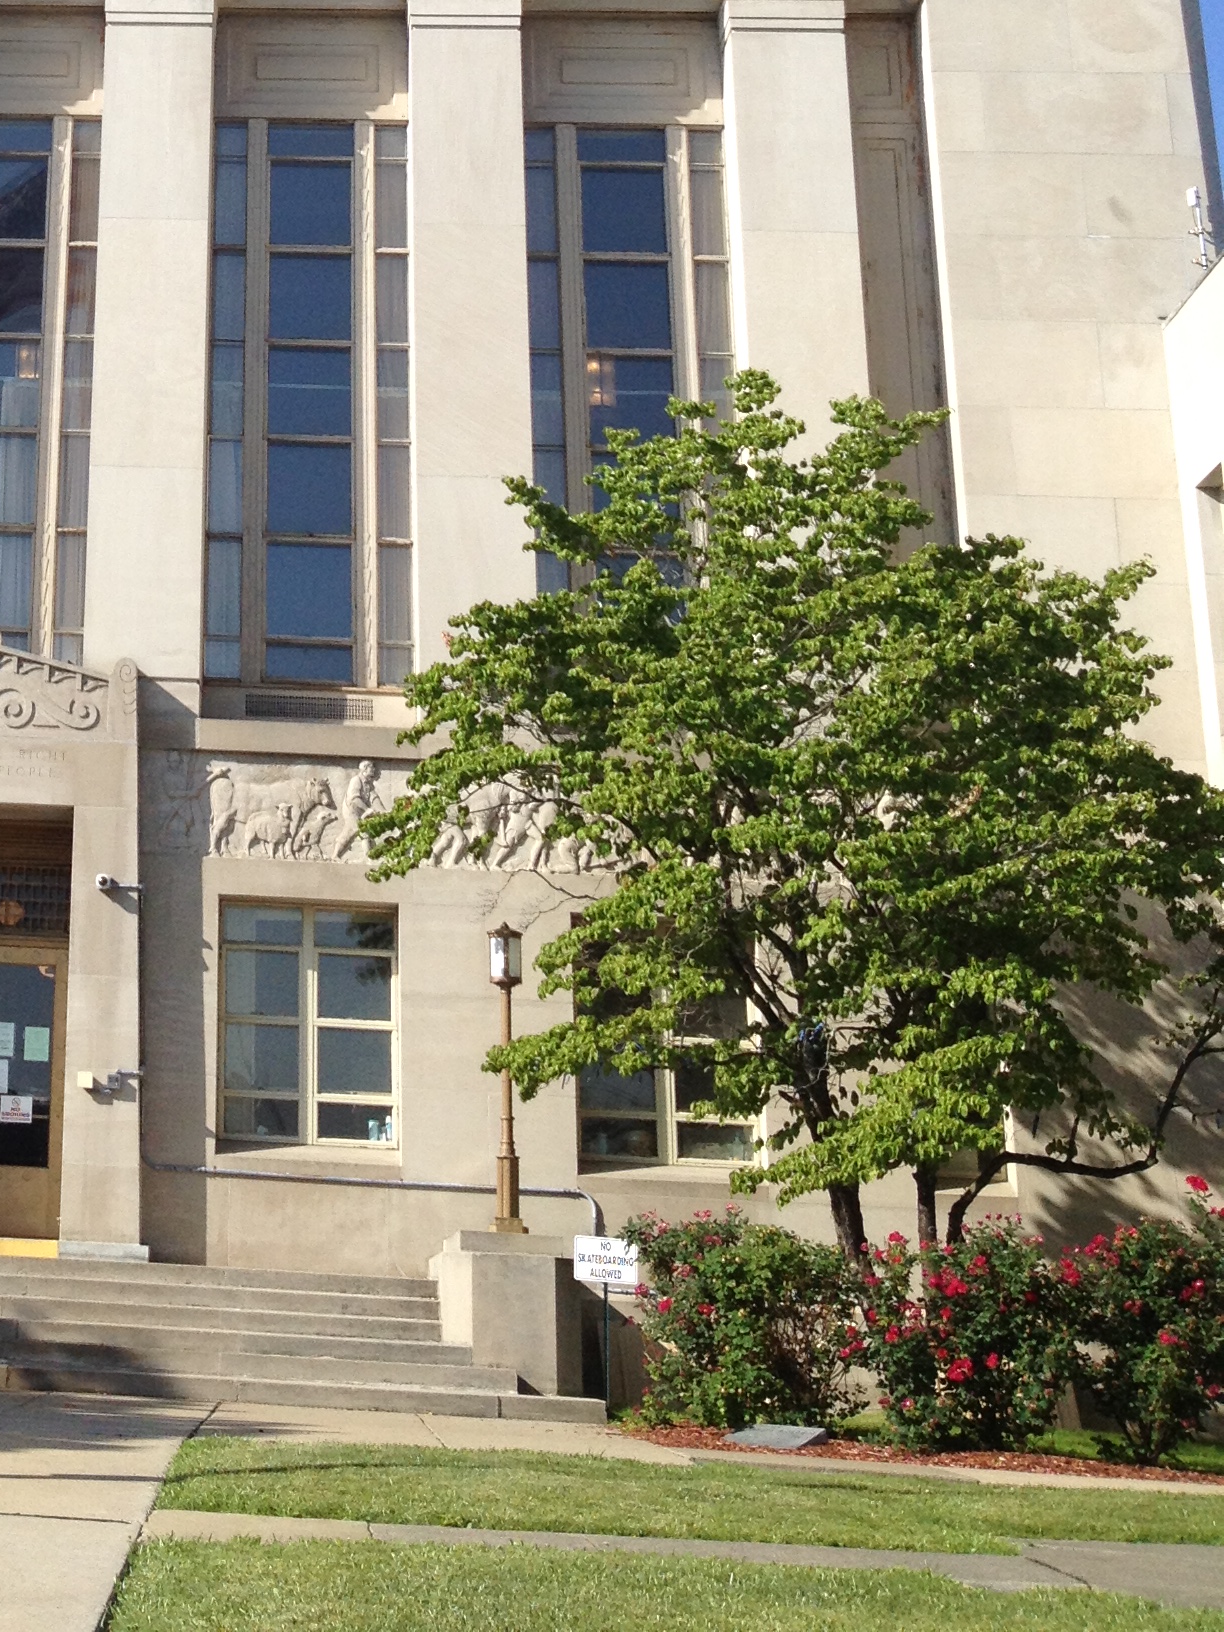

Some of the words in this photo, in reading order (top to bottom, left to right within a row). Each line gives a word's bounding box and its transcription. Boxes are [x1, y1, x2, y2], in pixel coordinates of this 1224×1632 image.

[19, 749, 67, 761] RIGHT
[600, 1241, 612, 1251] NO
[578, 1253, 635, 1266] SKATEBOARDING
[590, 1268, 622, 1279] ALLOWED
